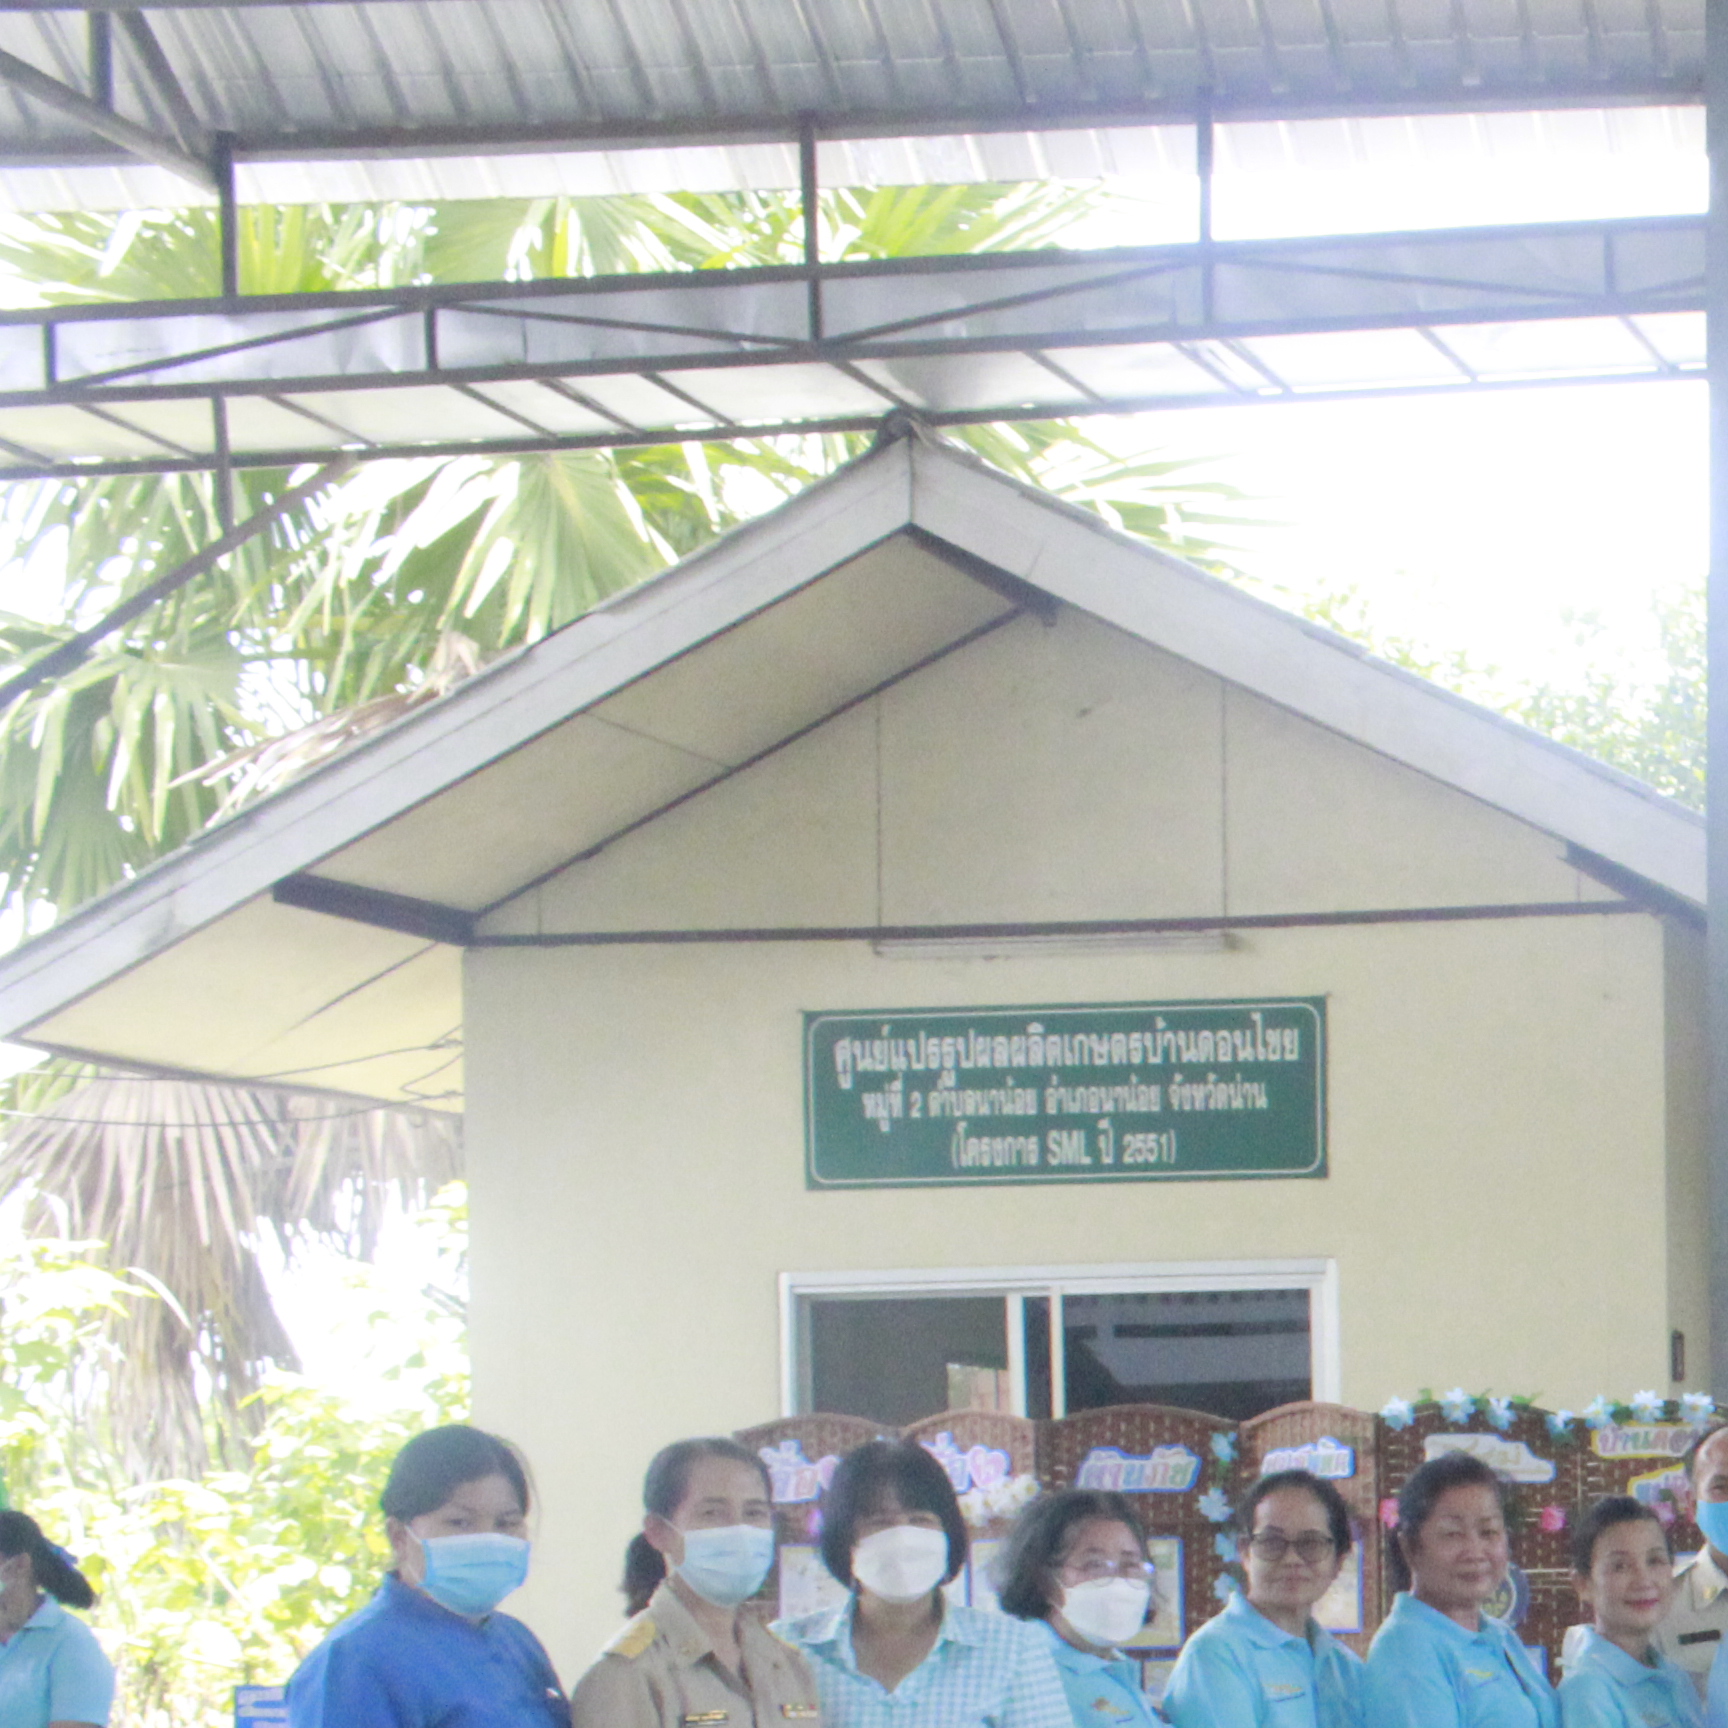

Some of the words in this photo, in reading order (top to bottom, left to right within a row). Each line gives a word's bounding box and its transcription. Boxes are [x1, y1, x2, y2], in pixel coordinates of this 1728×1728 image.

[909, 1093, 922, 1118] 2
[927, 1075, 1037, 1118] ตำบลนาน้อย
[1045, 1074, 1160, 1116] อำเภอนาน้อย
[1169, 1072, 1268, 1112] จังหวัดน่าน
[951, 1122, 1039, 1168] (โครงการ
[1047, 1132, 1091, 1165] SML
[1099, 1119, 1115, 1163] ปี
[1123, 1129, 1177, 1164] 2551)
